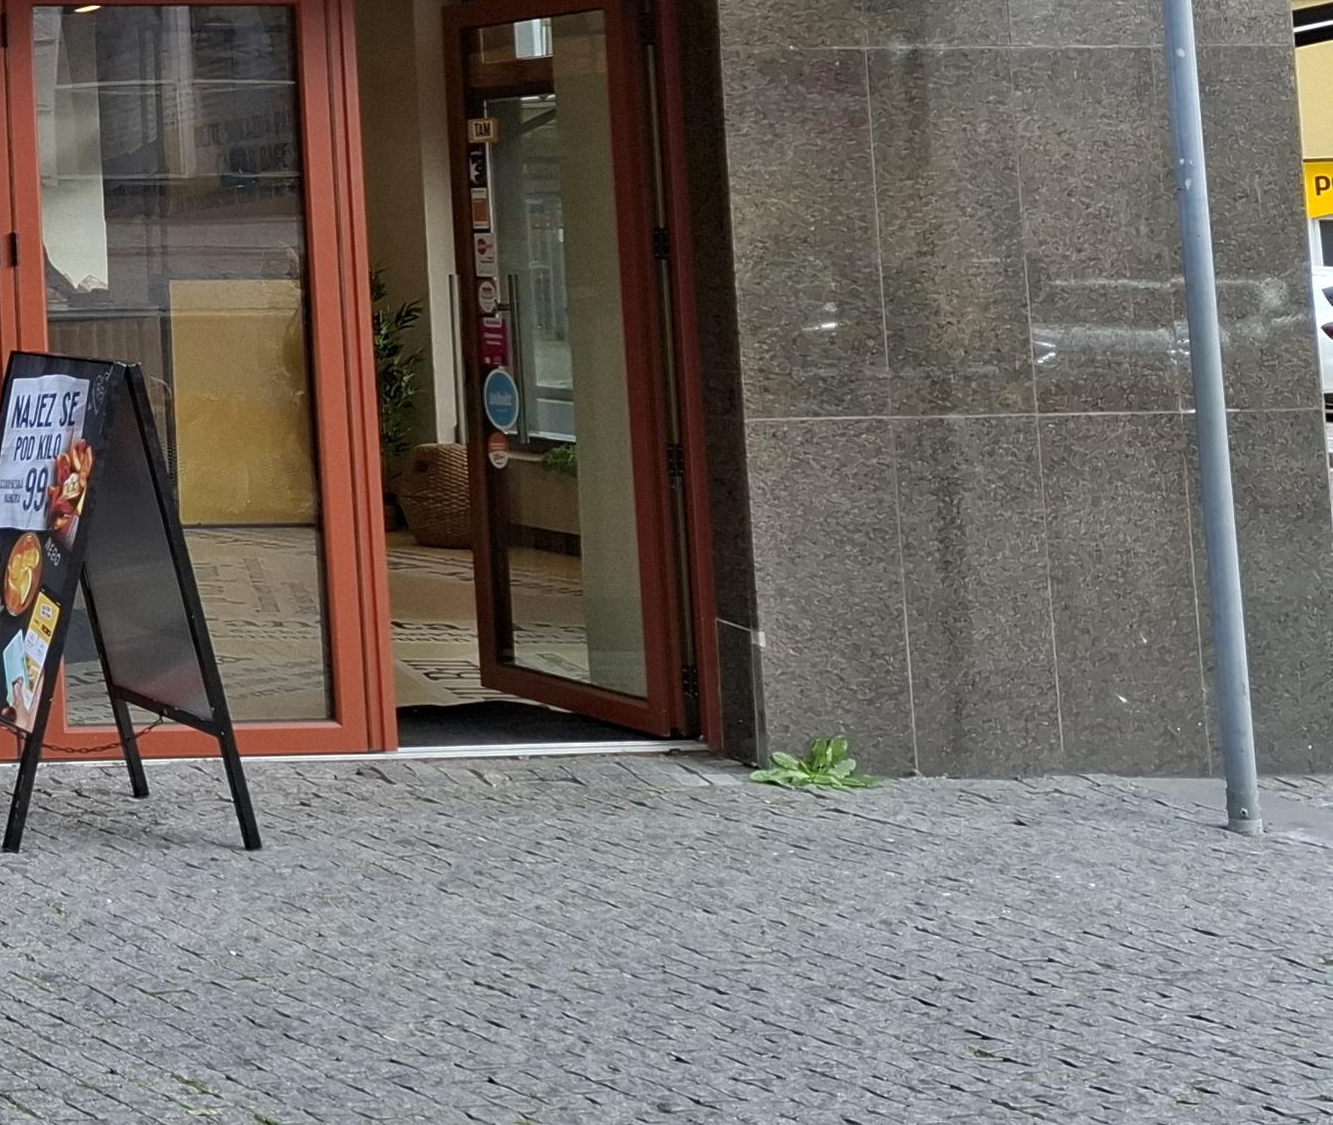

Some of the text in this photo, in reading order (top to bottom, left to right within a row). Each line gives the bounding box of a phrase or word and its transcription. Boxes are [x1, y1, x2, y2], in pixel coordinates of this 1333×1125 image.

[11, 391, 80, 429] NAJEZ SE
[13, 433, 62, 462] POD KILO
[22, 466, 49, 512] 99
